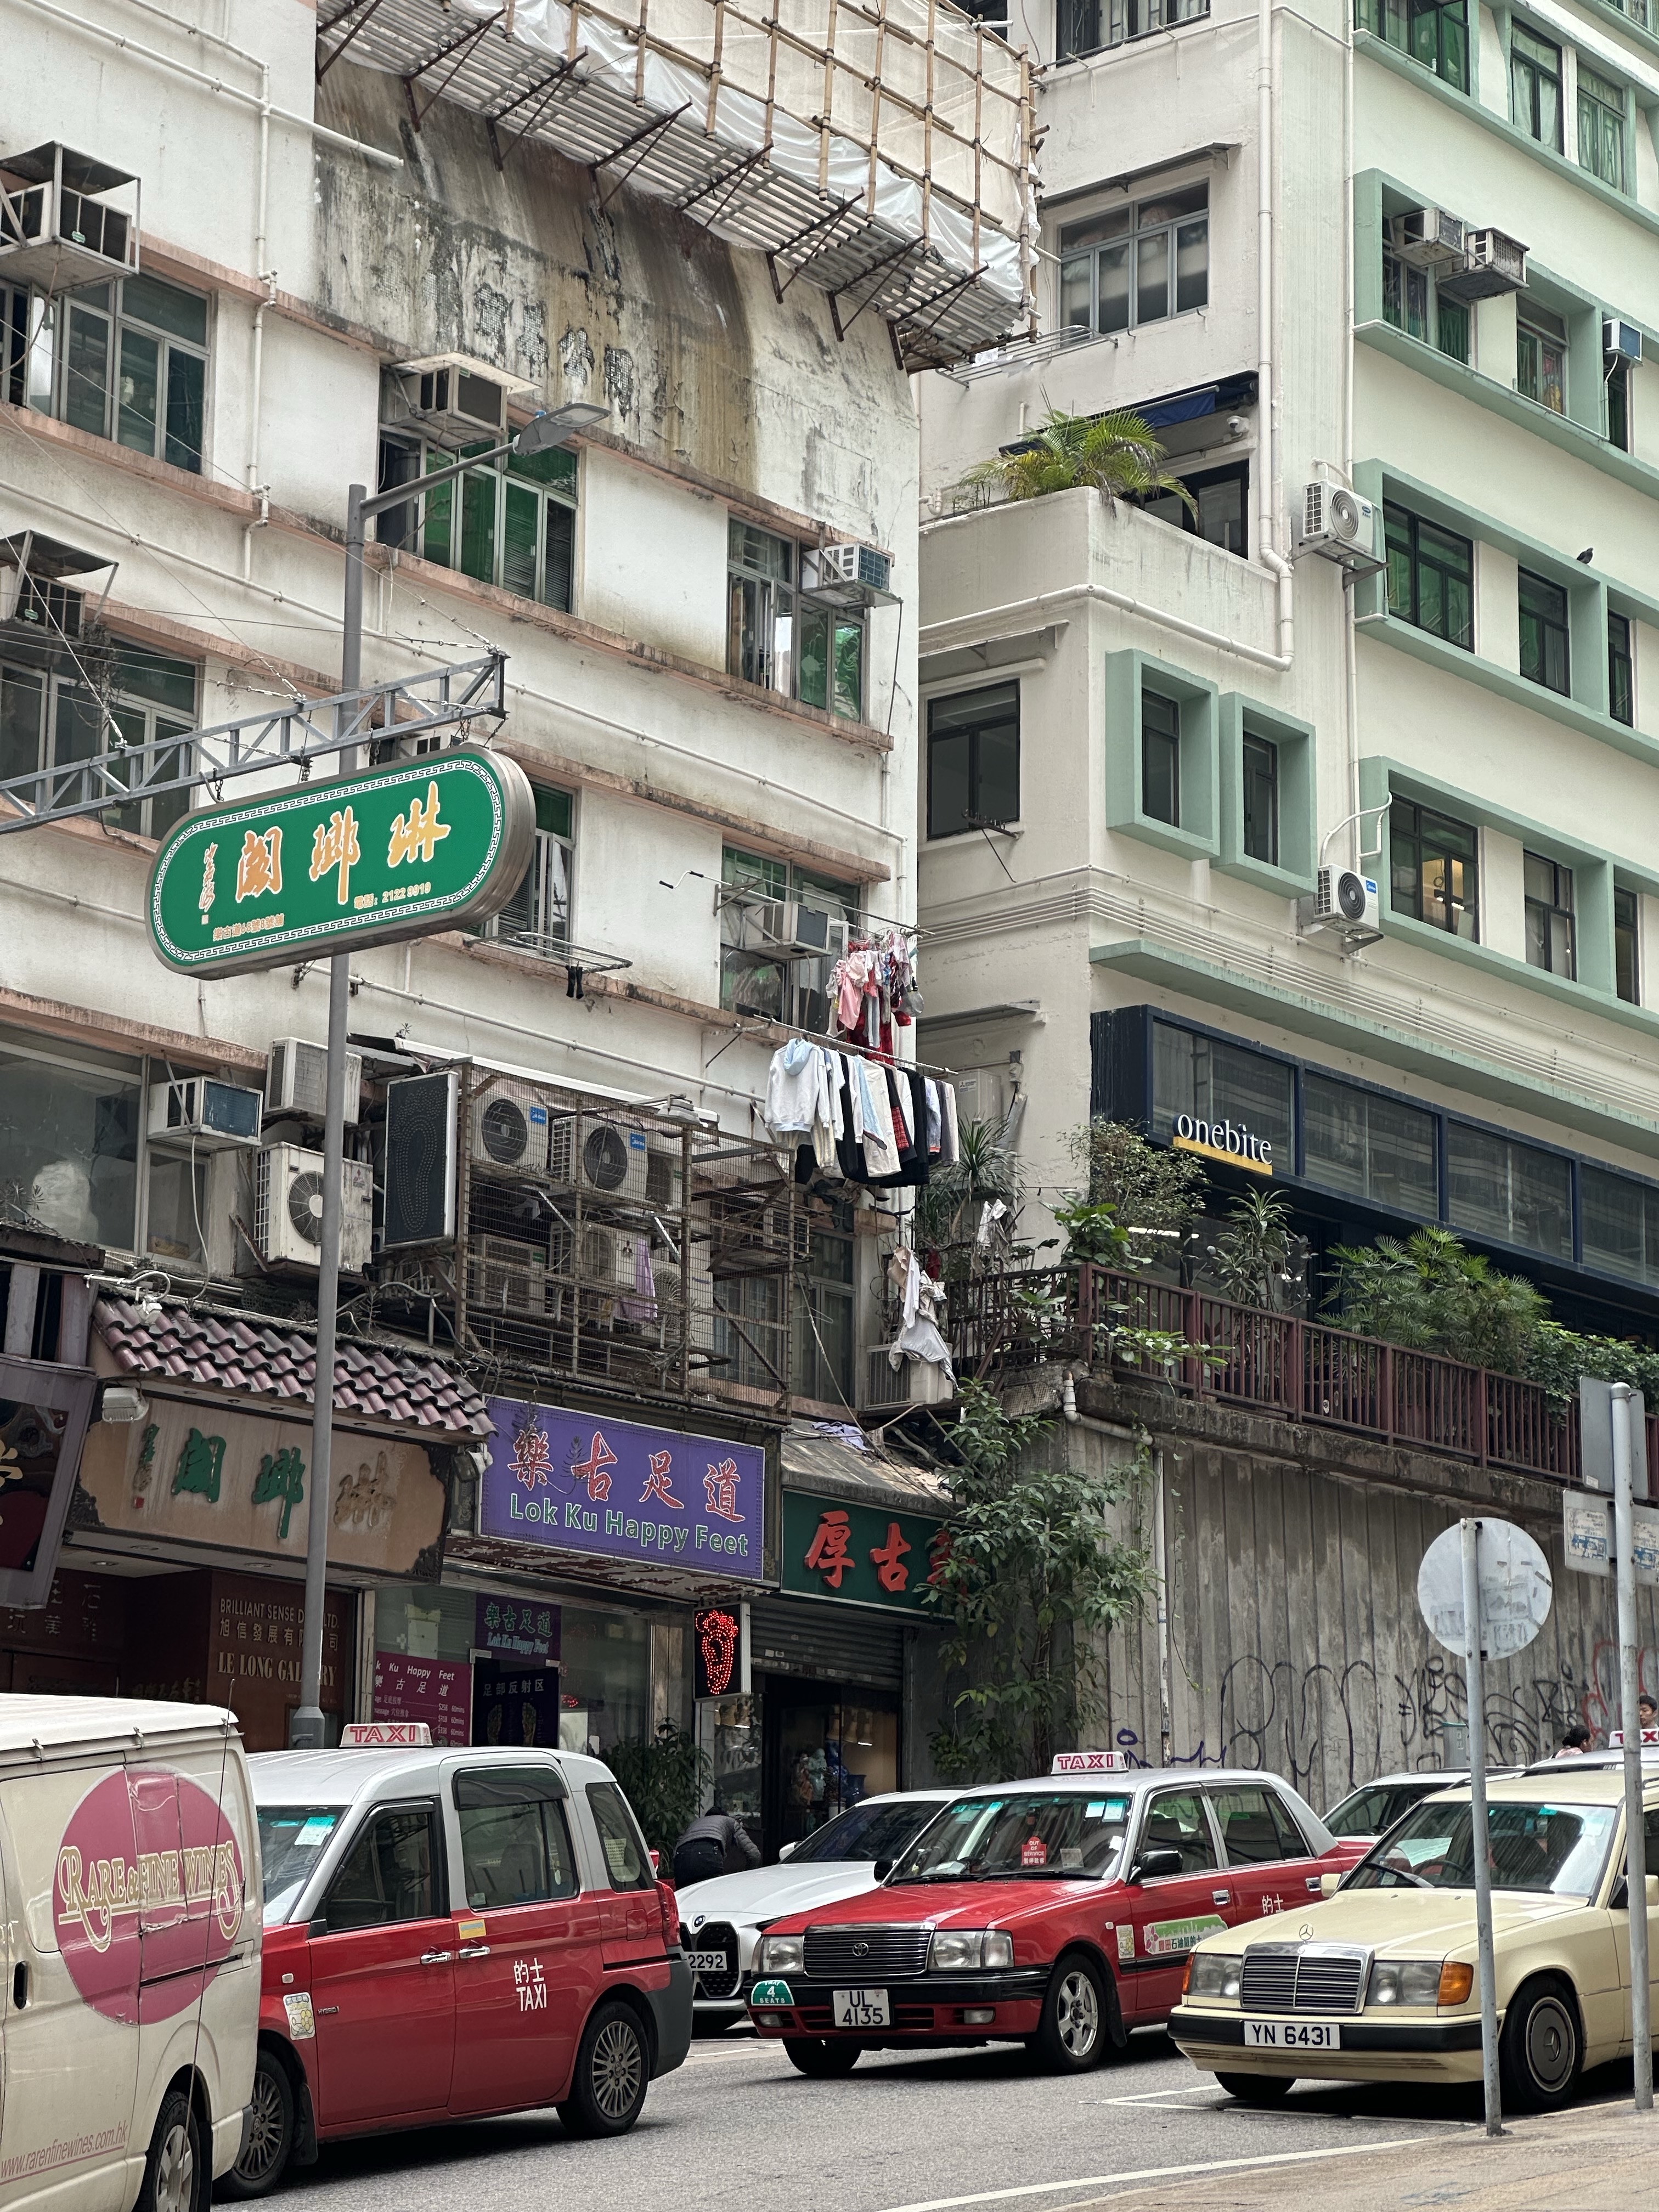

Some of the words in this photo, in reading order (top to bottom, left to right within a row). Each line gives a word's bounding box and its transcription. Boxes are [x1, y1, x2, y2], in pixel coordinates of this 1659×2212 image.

[382, 888, 406, 902] 2122
[407, 882, 431, 900] 9919
[1175, 1114, 1272, 1165] onebite
[507, 1429, 746, 1522] 樂古足道
[510, 1493, 558, 1526] Lok
[565, 1502, 597, 1532] Ku
[606, 1509, 689, 1552] Happy
[695, 1525, 748, 1556] Feet
[221, 1598, 264, 1618] BRILLIANT
[267, 1604, 294, 1622] SENSE
[484, 1602, 552, 1637] 樂古足道
[220, 1619, 338, 1652] 旭信發展有司
[218, 1652, 234, 1673] LE
[239, 1655, 273, 1679] LONG
[278, 1660, 337, 1686] GALRY
[389, 1663, 398, 1672] Ku
[407, 1665, 431, 1679] Happy
[439, 1670, 455, 1680] Feet
[375, 1675, 449, 1696] 樂古足道
[483, 1679, 544, 1696] 足部反射区
[350, 1725, 416, 1742] TAXI
[1615, 1730, 1659, 1744] TX
[1057, 1754, 1113, 1770] TAXI
[1262, 1893, 1284, 1914] 的士
[514, 1957, 544, 1984] 的士
[688, 1954, 724, 1968] 2292
[516, 1983, 547, 2012] TAXI
[767, 1986, 775, 1997] 4
[849, 1991, 873, 2007] UL
[843, 2007, 884, 2025] 4135
[1252, 2024, 1276, 2044] YN
[1284, 2026, 1330, 2046] 6431
[1, 2120, 128, 2178] www.rarenfinewines.com.hk
